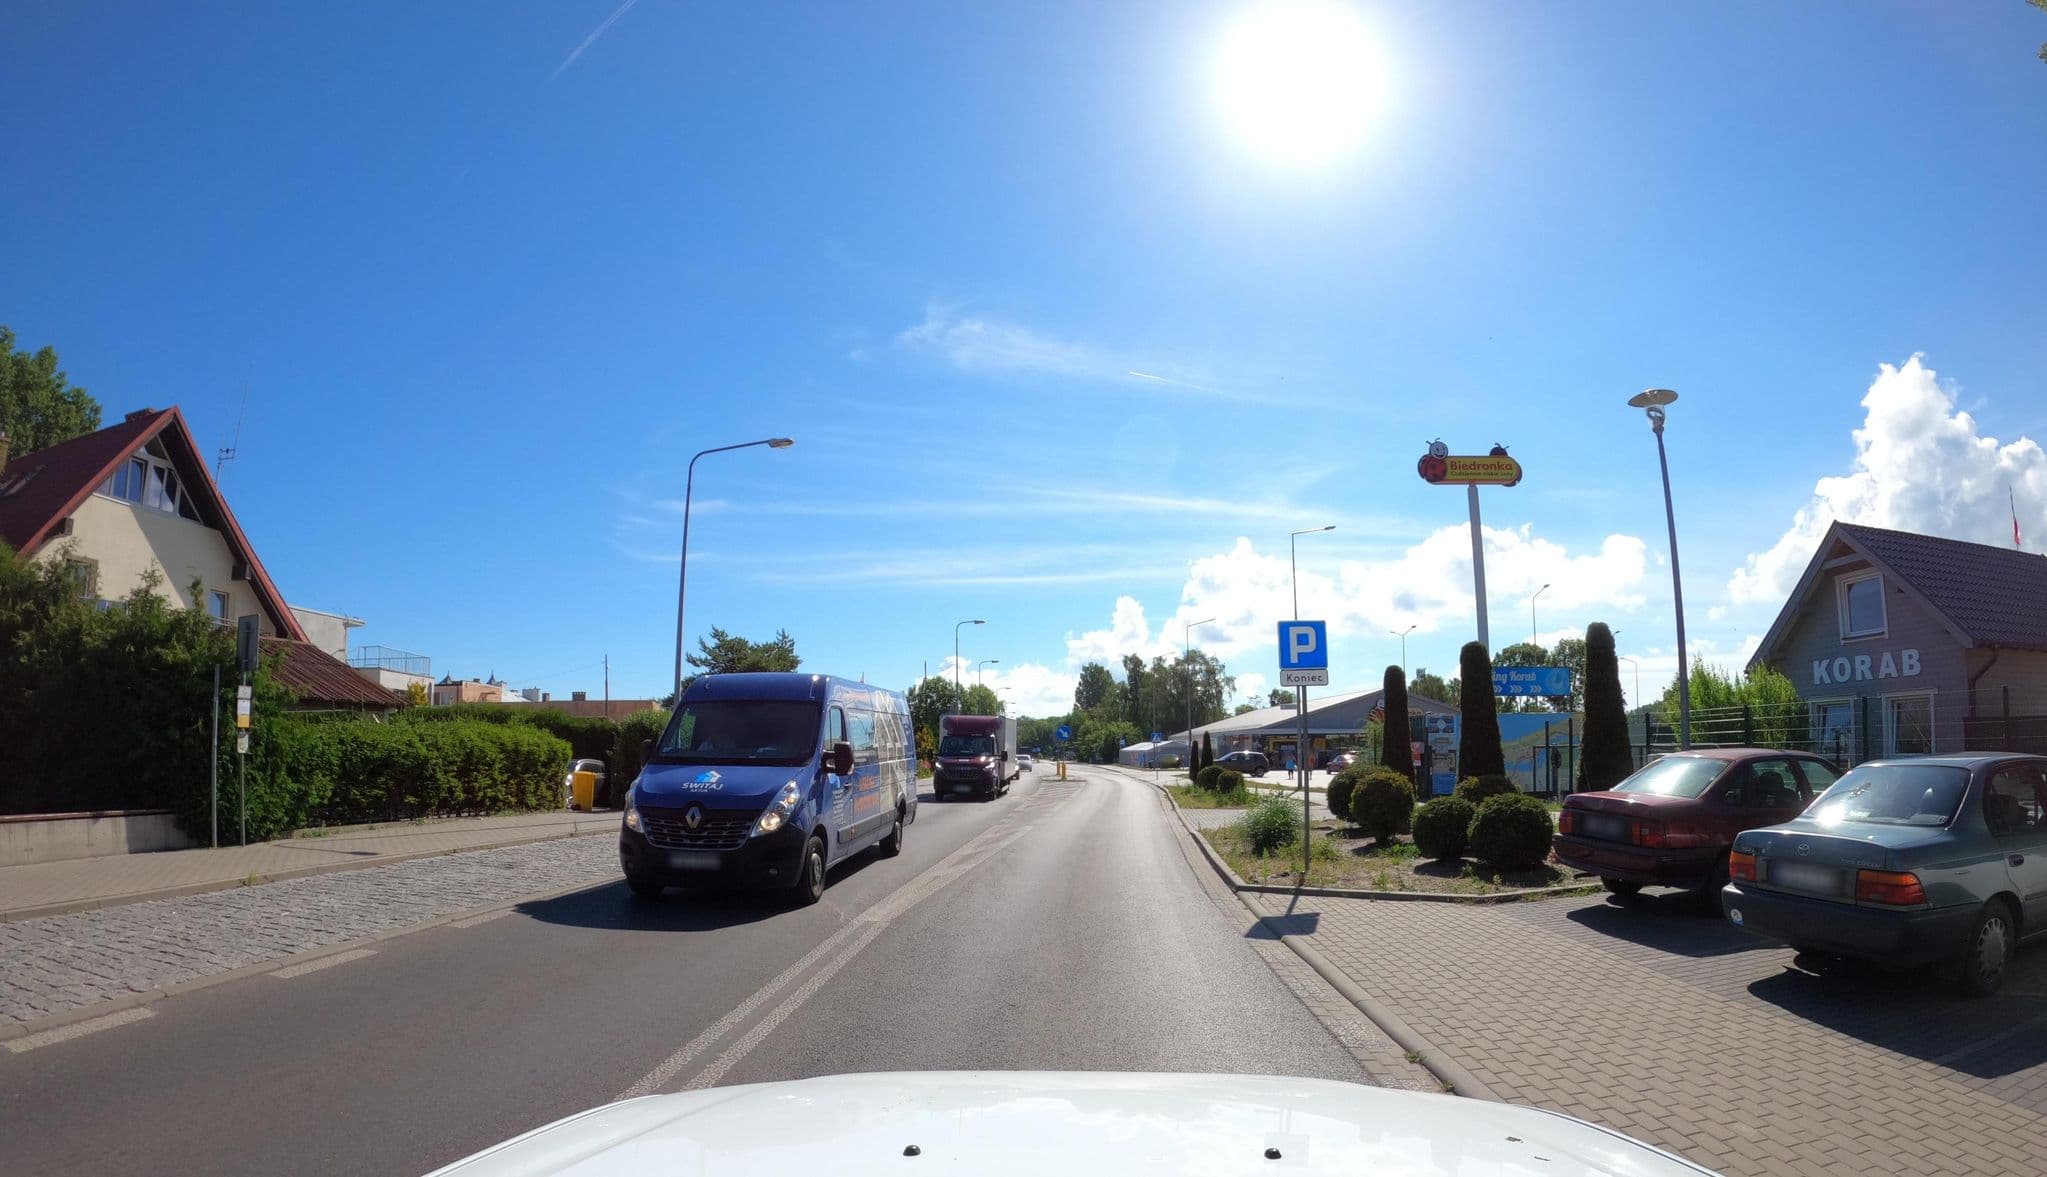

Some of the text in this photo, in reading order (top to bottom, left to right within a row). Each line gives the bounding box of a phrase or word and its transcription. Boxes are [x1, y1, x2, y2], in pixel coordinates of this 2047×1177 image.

[1450, 461, 1513, 471] Biedronka
[1289, 626, 1316, 663] P
[1812, 649, 1921, 685] KORAB
[1286, 673, 1323, 682] Koniec
[1509, 671, 1537, 681] Korab
